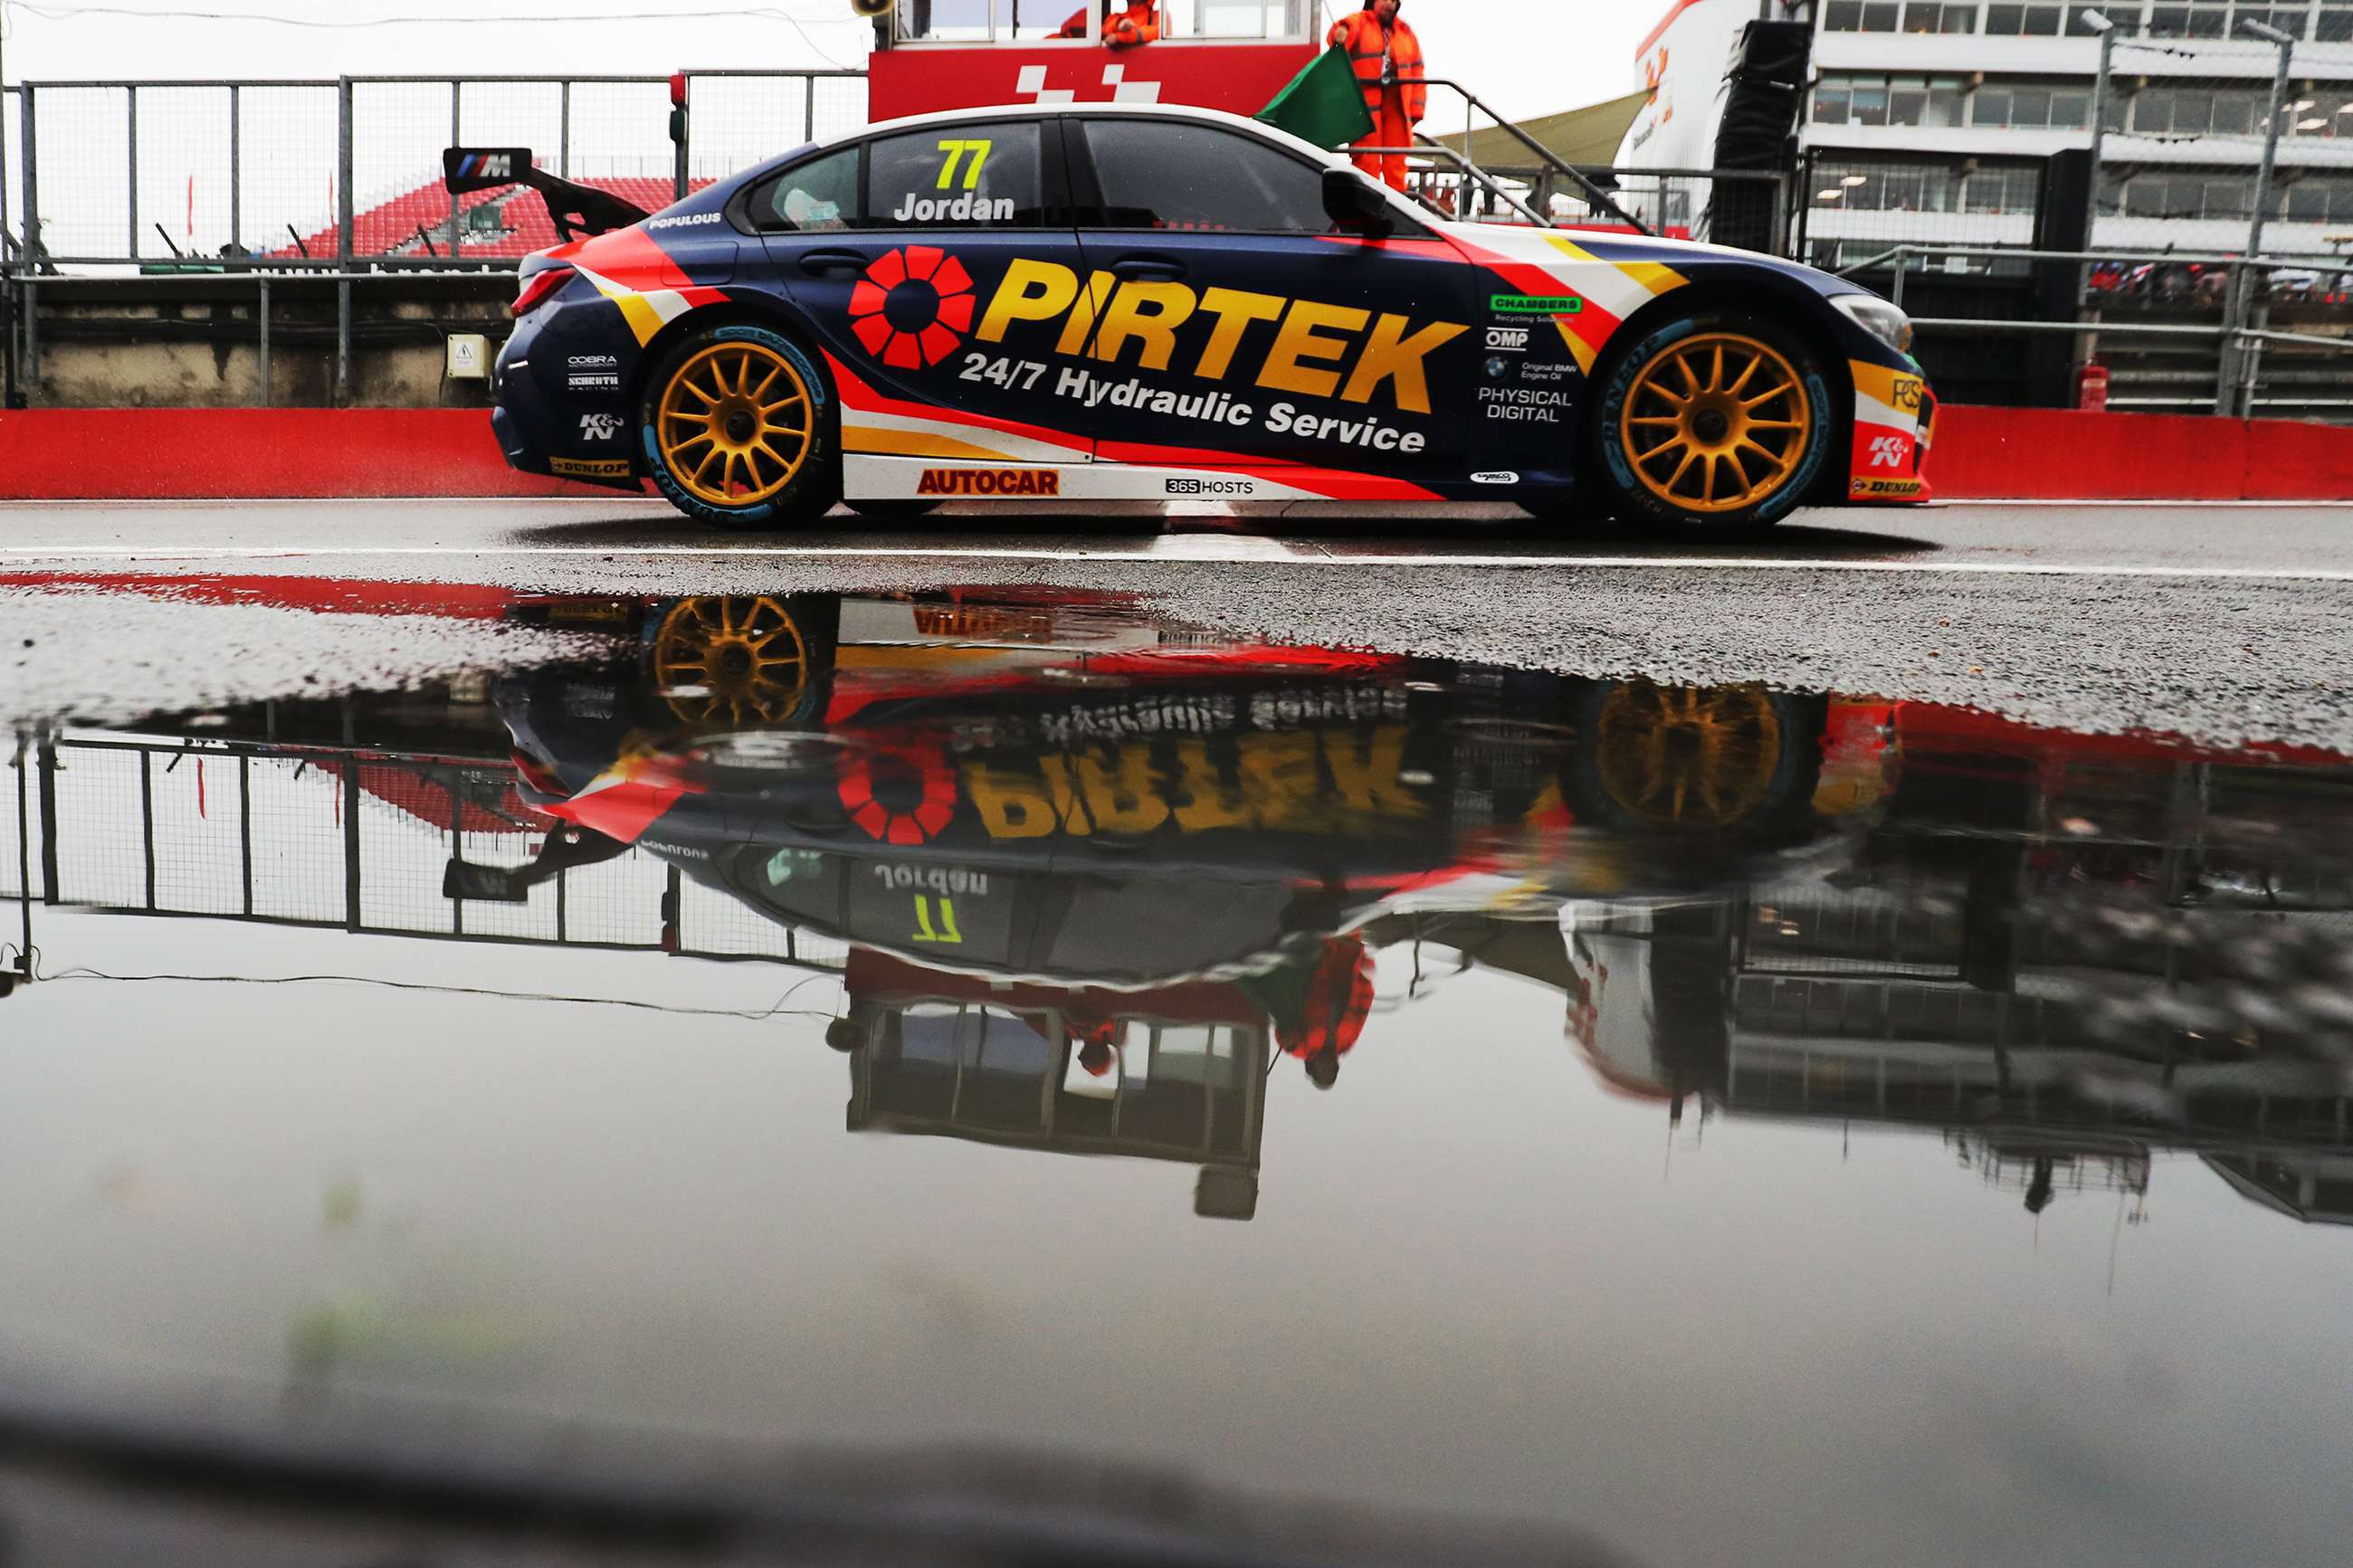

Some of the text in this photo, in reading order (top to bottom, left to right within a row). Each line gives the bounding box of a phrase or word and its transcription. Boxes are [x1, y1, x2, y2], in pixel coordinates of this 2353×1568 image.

[936, 139, 992, 189] 77
[894, 192, 1015, 222] Jordan
[648, 212, 721, 231] POPULOUS
[1495, 298, 1577, 309] CHAMBERS
[1495, 314, 1535, 323] Recycling
[975, 258, 1472, 414] PIRTEK
[1485, 330, 1529, 347] OMP
[567, 356, 617, 364] COBRA
[1521, 362, 1577, 373] Original BMW
[1520, 371, 1562, 381] Engine Oil
[958, 353, 1426, 453] 24/7 Hydraulic Service
[1478, 387, 1573, 406] PHYSICAL
[1487, 404, 1560, 423] DIGITAL
[579, 413, 624, 441] K&N
[565, 461, 628, 473] DUNLOP
[917, 469, 1059, 495] AUTOCAR
[1167, 480, 1253, 494] 365 HOSTS
[1869, 481, 1921, 493] DUNLOP
